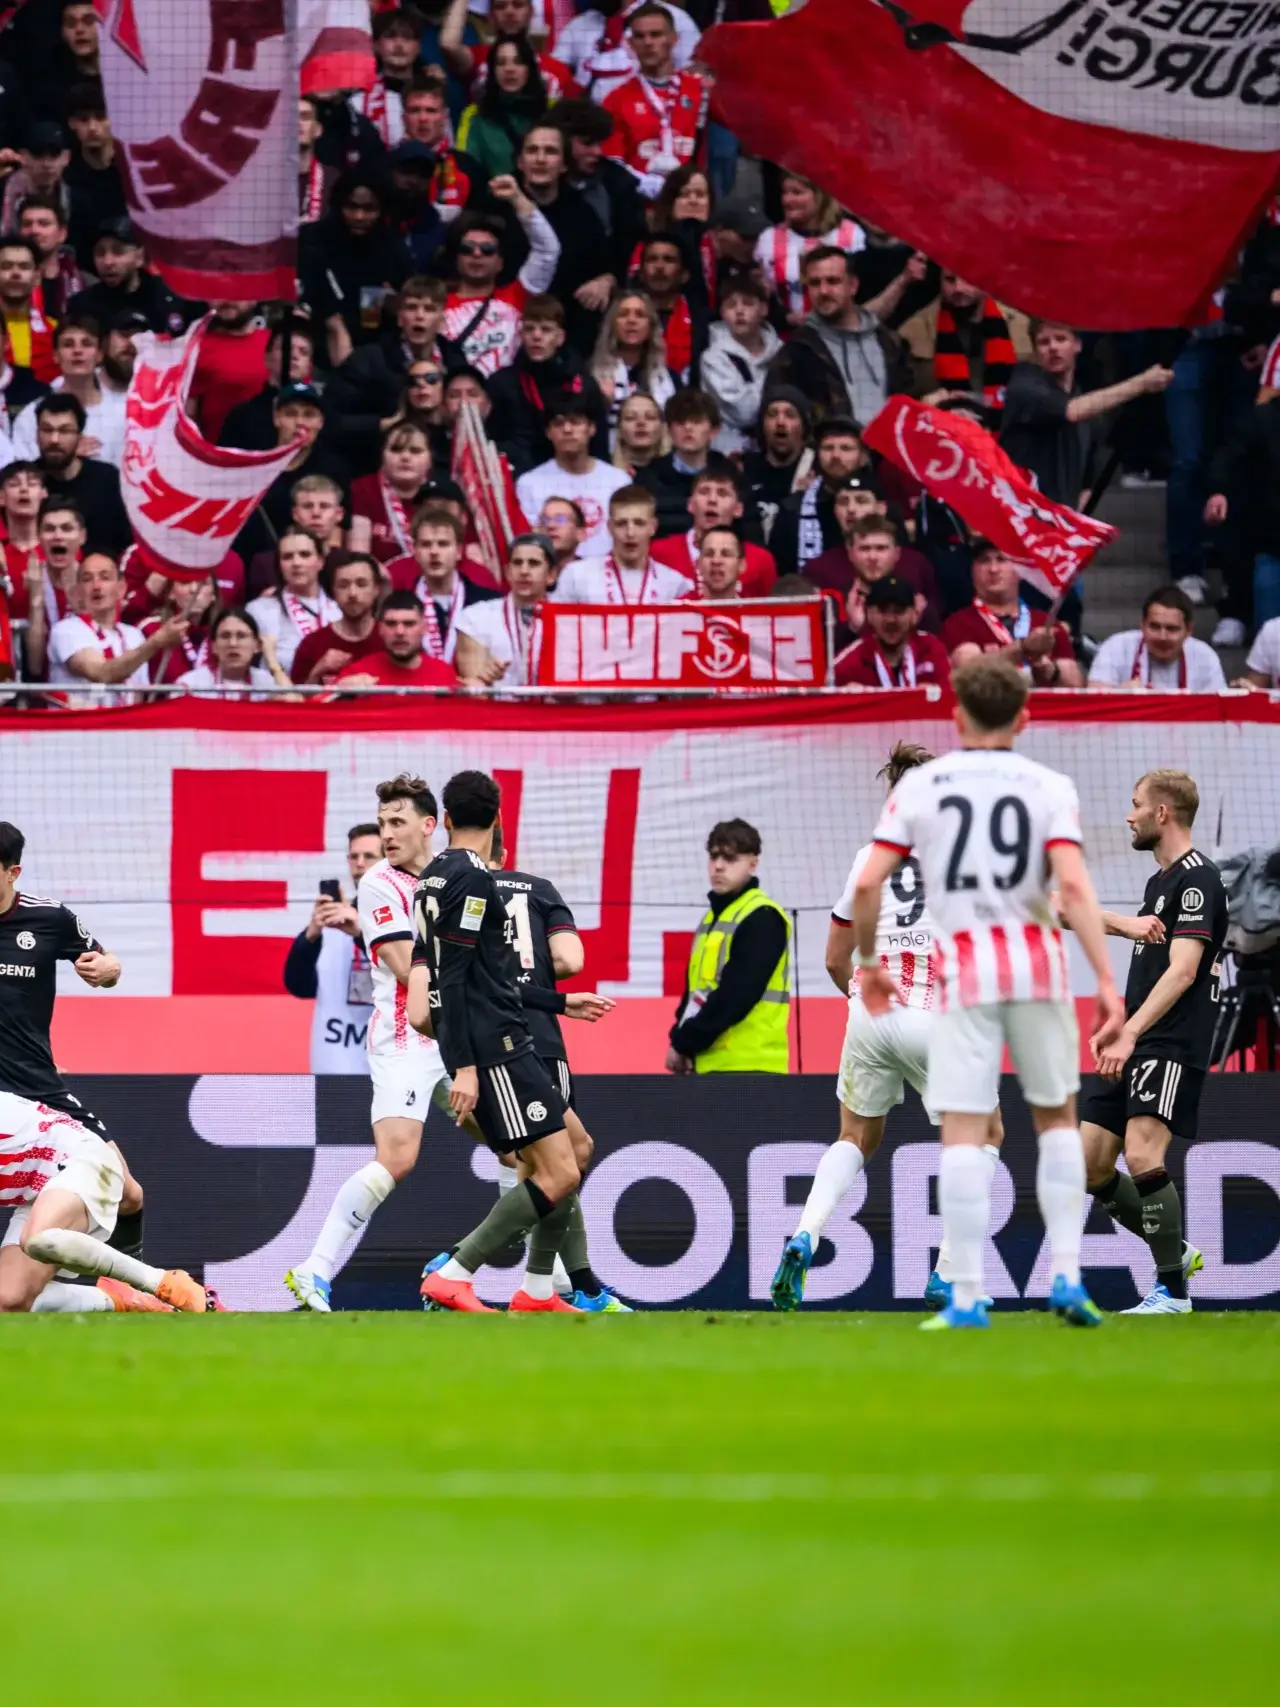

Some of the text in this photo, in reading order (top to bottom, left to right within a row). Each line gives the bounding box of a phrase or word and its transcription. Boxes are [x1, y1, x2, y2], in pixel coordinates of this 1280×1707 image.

[554, 612, 705, 682] IWF
[938, 794, 1032, 894] 29
[495, 879, 533, 892] NCHEN
[890, 852, 926, 928] 9
[1177, 912, 1204, 923] Allianz
